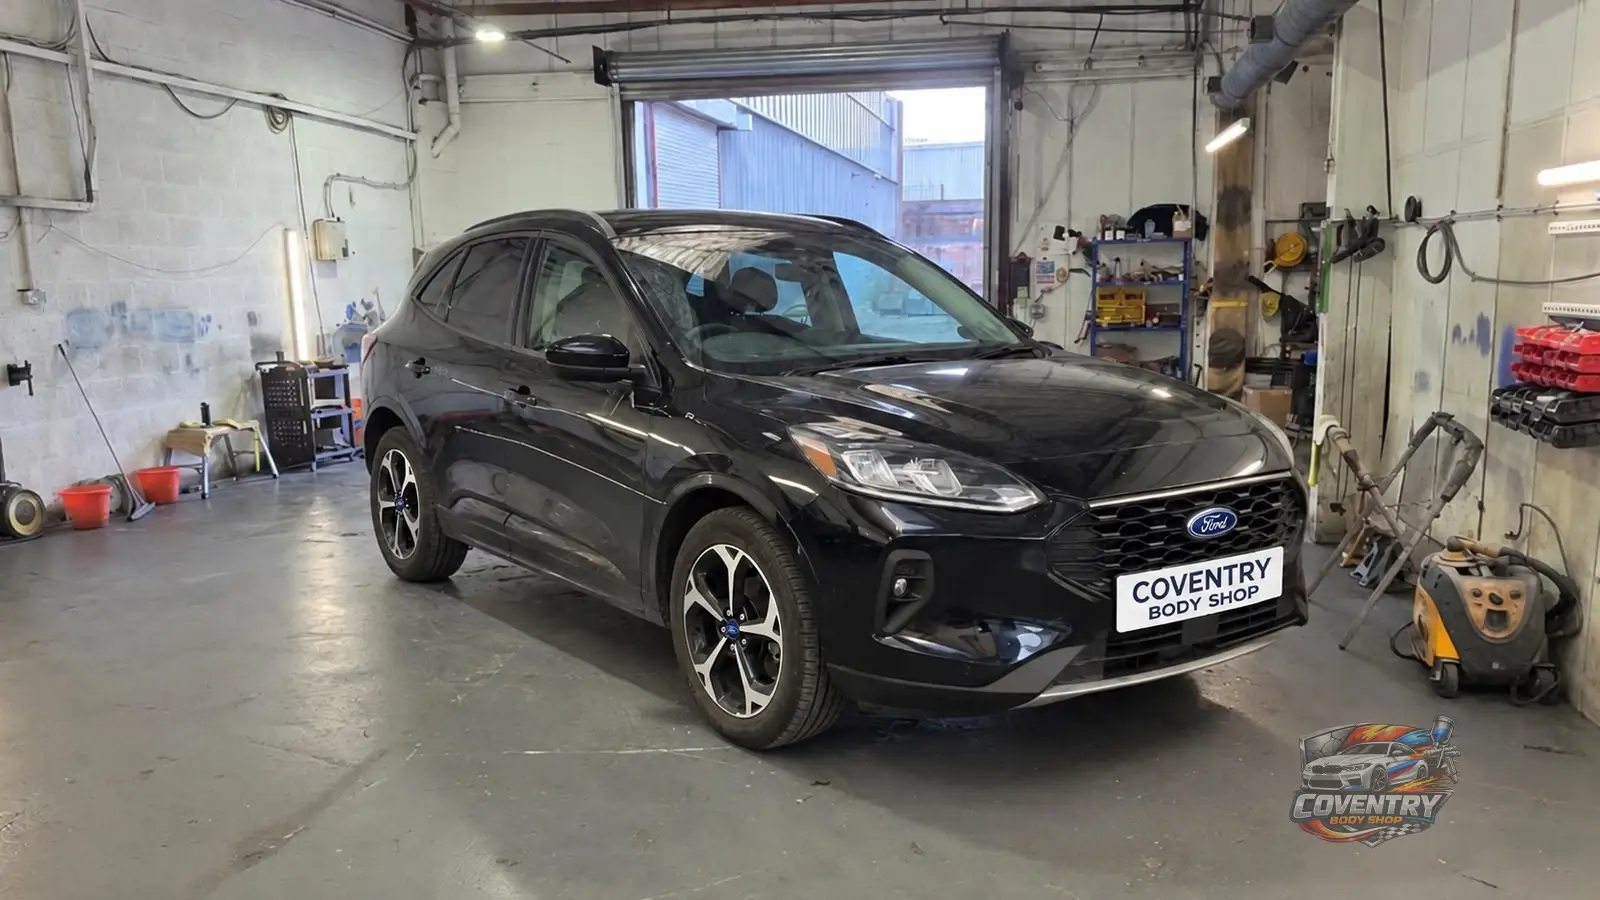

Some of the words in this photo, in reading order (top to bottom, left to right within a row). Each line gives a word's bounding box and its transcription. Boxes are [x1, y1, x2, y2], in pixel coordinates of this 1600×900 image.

[1201, 514, 1227, 532] Ford
[1132, 557, 1272, 603] COVENTRY
[1149, 598, 1202, 620] BODY
[1208, 585, 1259, 607] SHOP
